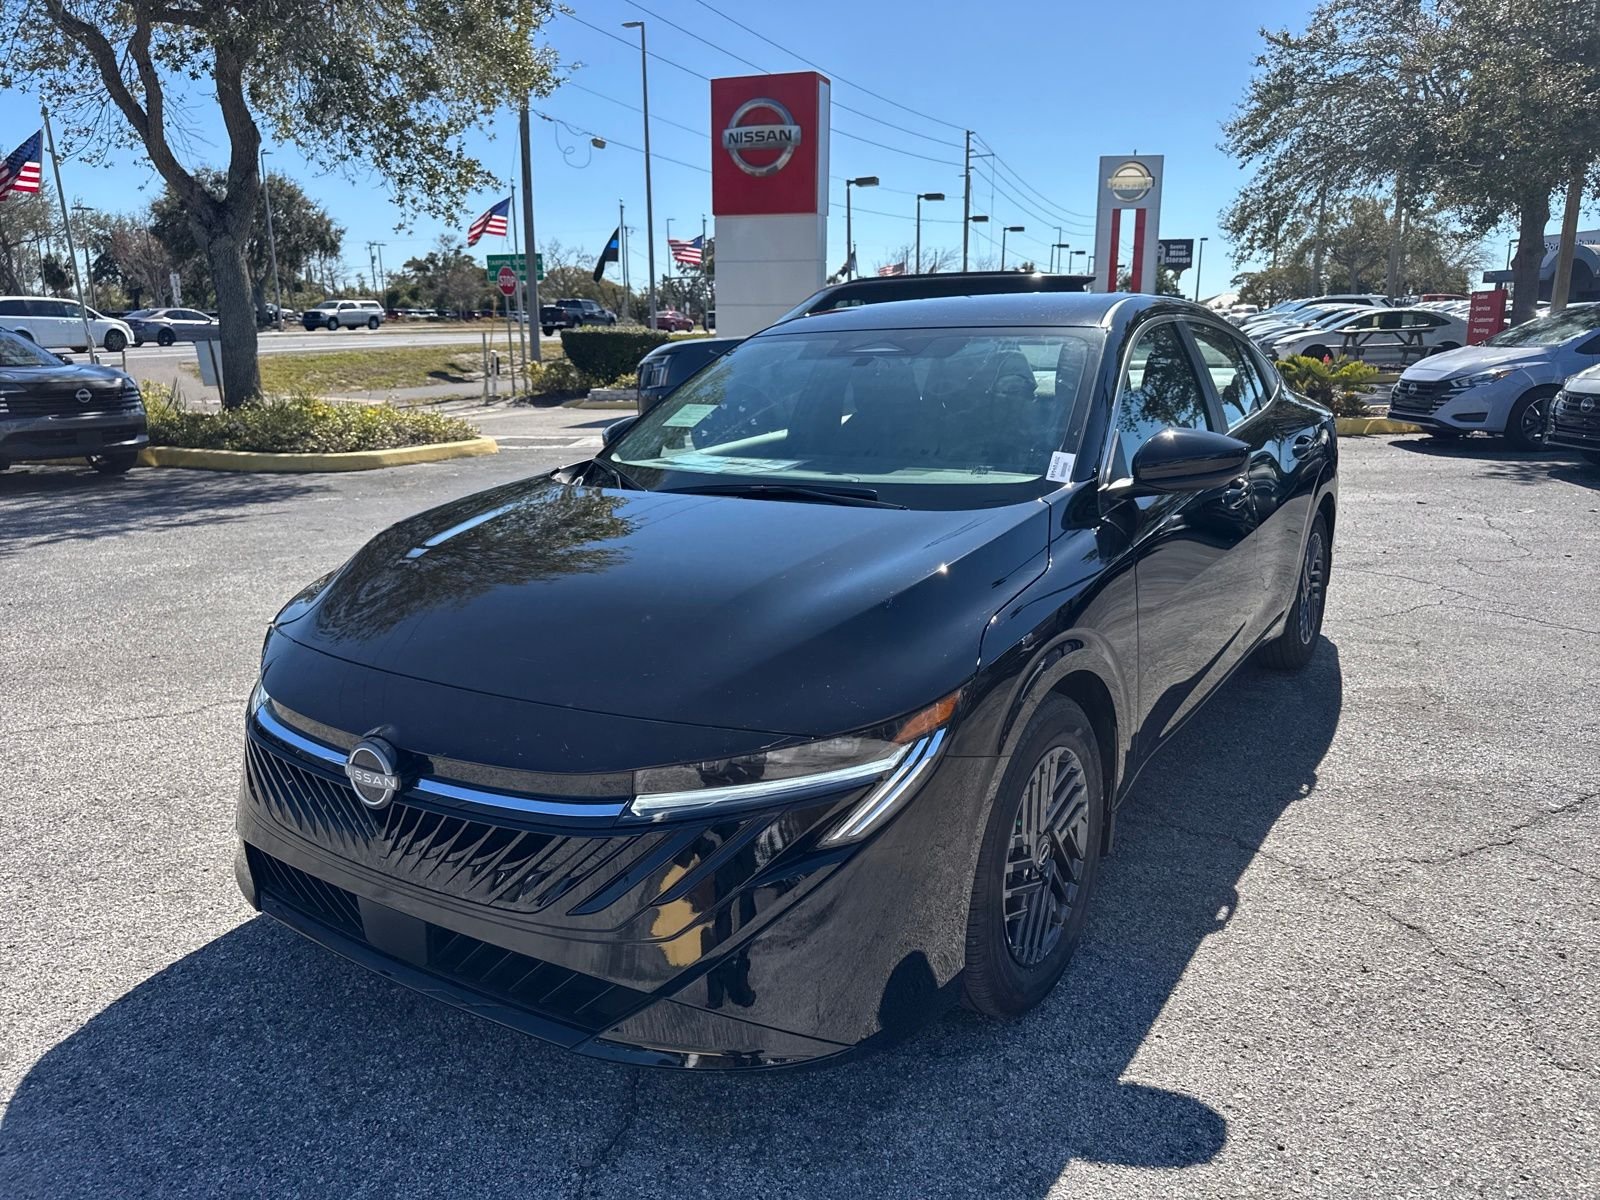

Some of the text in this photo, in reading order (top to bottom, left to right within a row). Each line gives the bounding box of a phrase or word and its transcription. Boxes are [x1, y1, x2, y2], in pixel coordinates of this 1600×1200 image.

[728, 129, 792, 145] NISSAN
[499, 275, 517, 287] STOP
[1472, 327, 1489, 335] Parking
